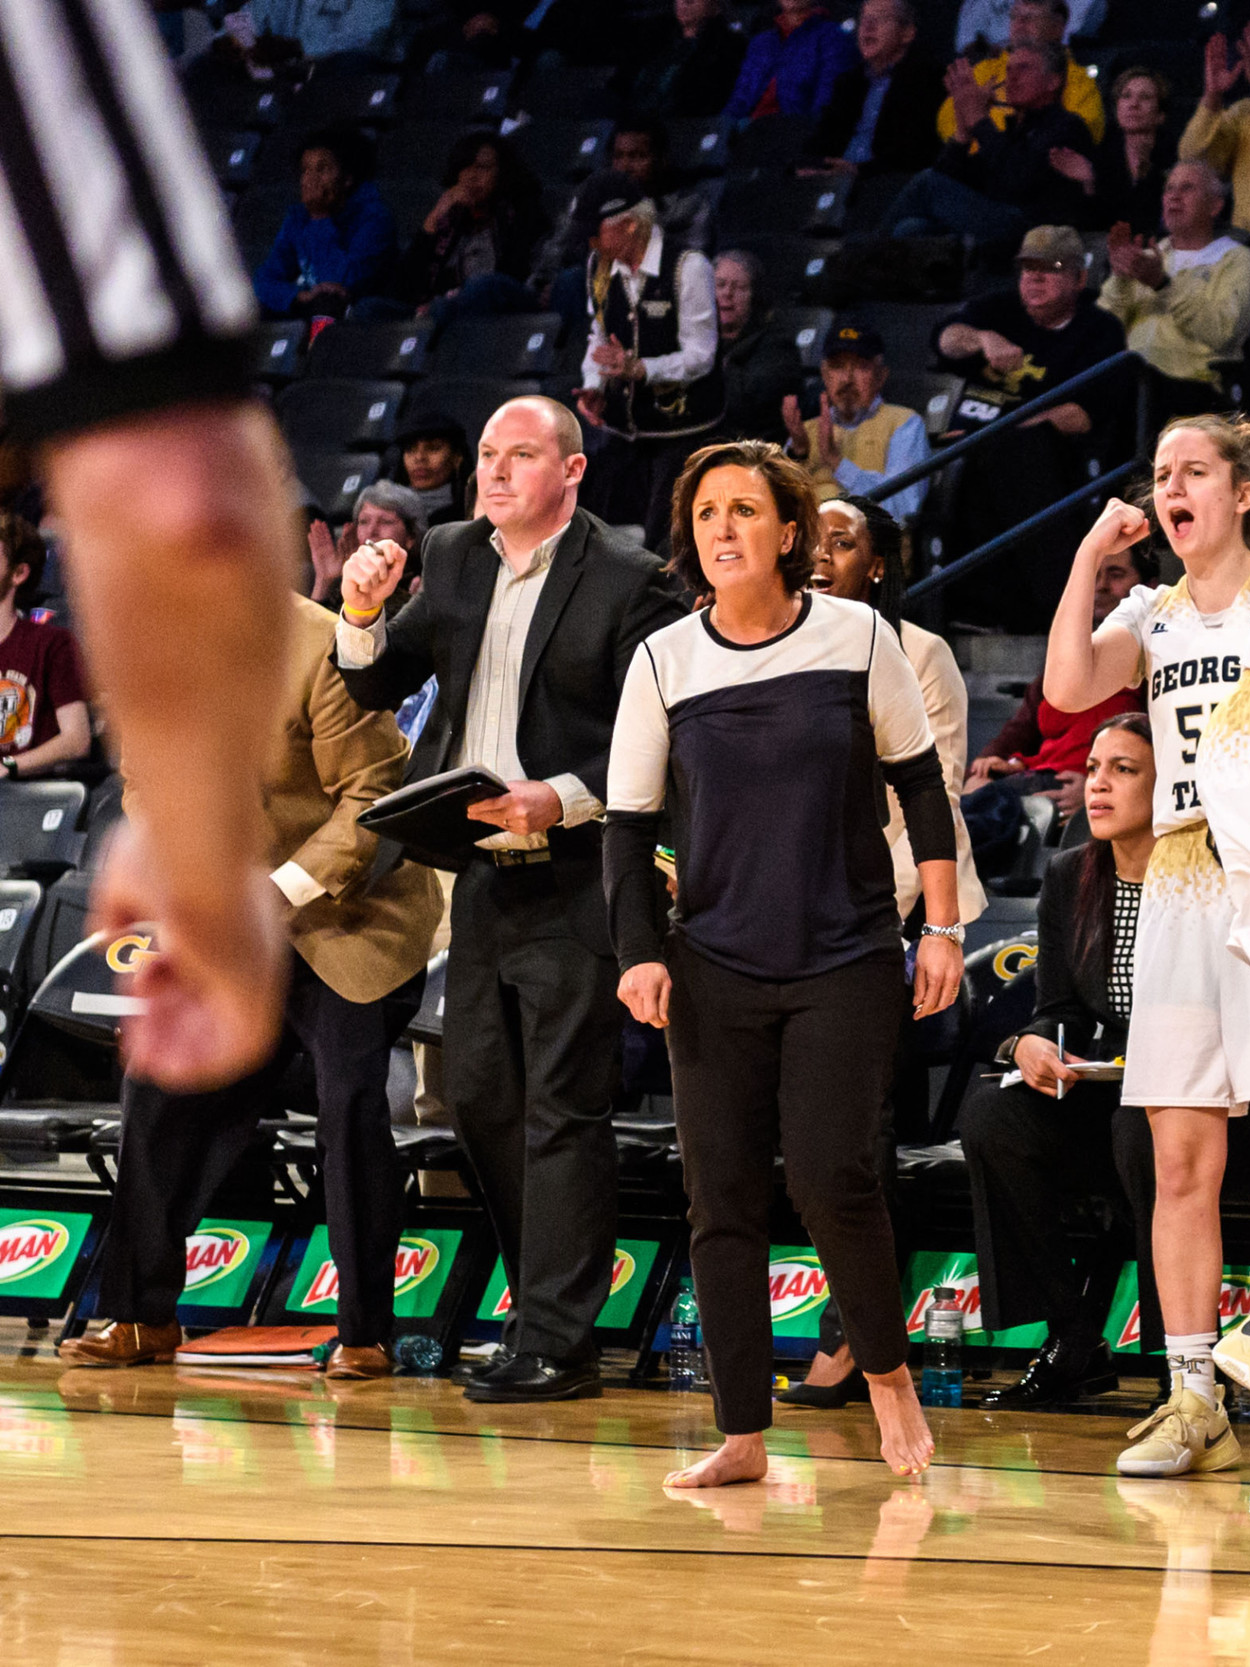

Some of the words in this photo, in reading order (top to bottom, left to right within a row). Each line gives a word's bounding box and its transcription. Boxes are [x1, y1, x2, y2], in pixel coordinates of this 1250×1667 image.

[1151, 655, 1241, 701] GEORG
[993, 943, 1039, 981] G
[0, 1231, 60, 1266] MAN
[769, 1269, 828, 1302] MAN
[1167, 1354, 1206, 1374] GT
